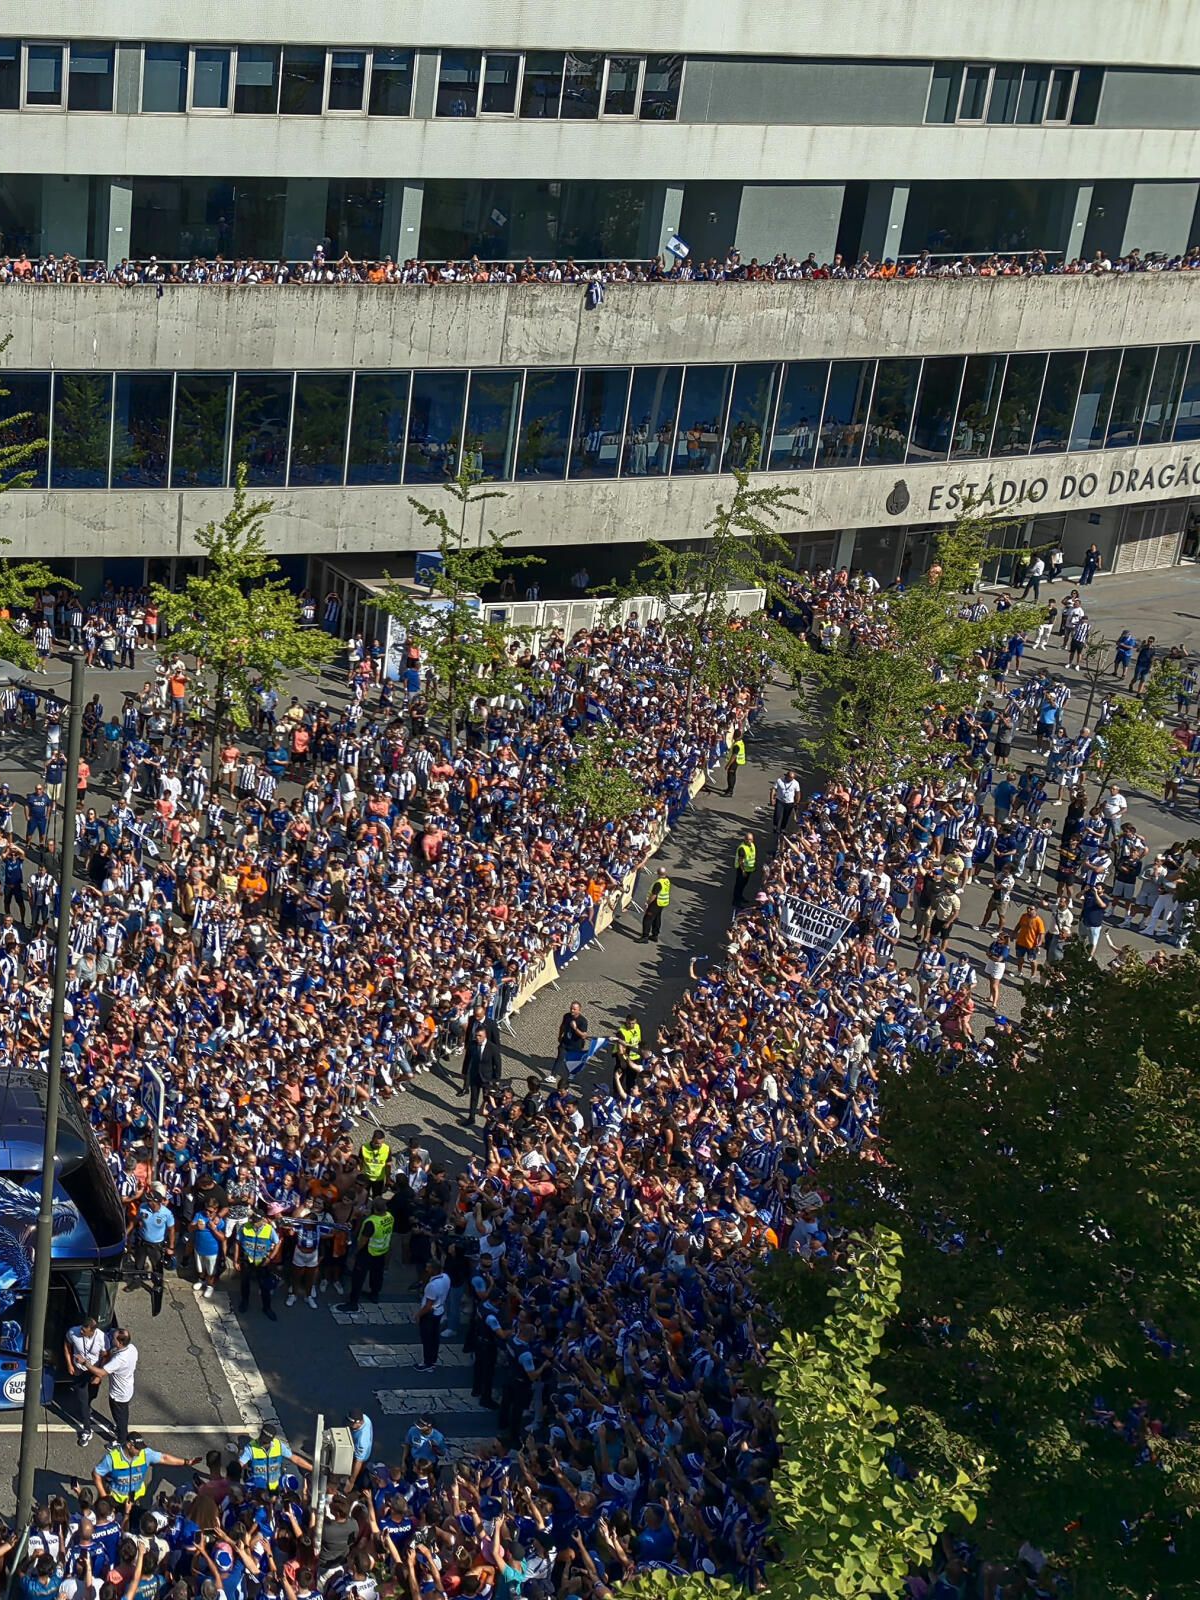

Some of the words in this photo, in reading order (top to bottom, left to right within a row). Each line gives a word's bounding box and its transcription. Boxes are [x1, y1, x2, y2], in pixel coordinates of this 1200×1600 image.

[928, 474, 1049, 511] ESTÁDIO
[1060, 473, 1098, 500] DO
[784, 895, 849, 931] FRANCESCO
[790, 912, 834, 939] FARIOLI
[92, 1531, 106, 1539] SUPER
[107, 1527, 119, 1535] BOCK
